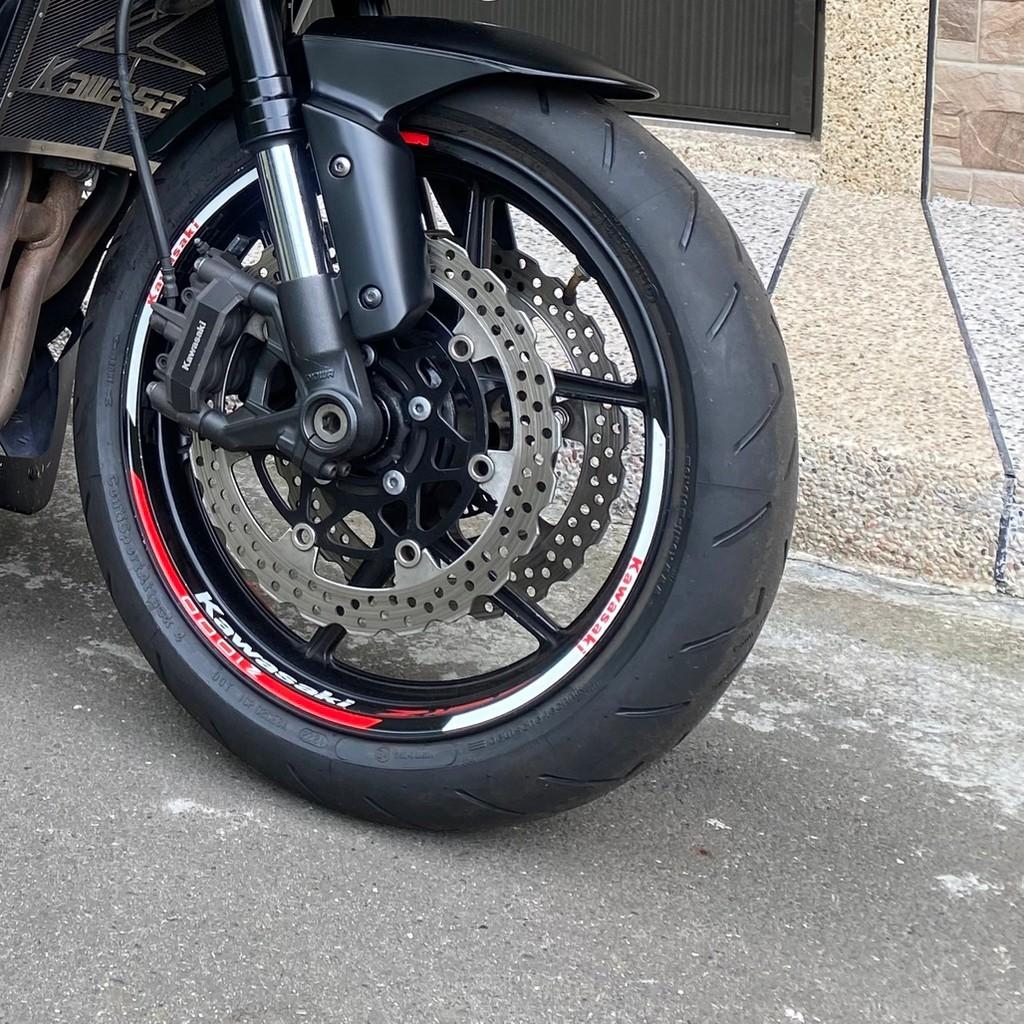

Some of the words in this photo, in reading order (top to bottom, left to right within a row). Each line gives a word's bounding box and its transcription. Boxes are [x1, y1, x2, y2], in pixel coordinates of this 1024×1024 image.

[181, 319, 207, 371] Kawasaki
[194, 591, 356, 710] Kawasaki
[576, 556, 644, 655] Kawasaki
